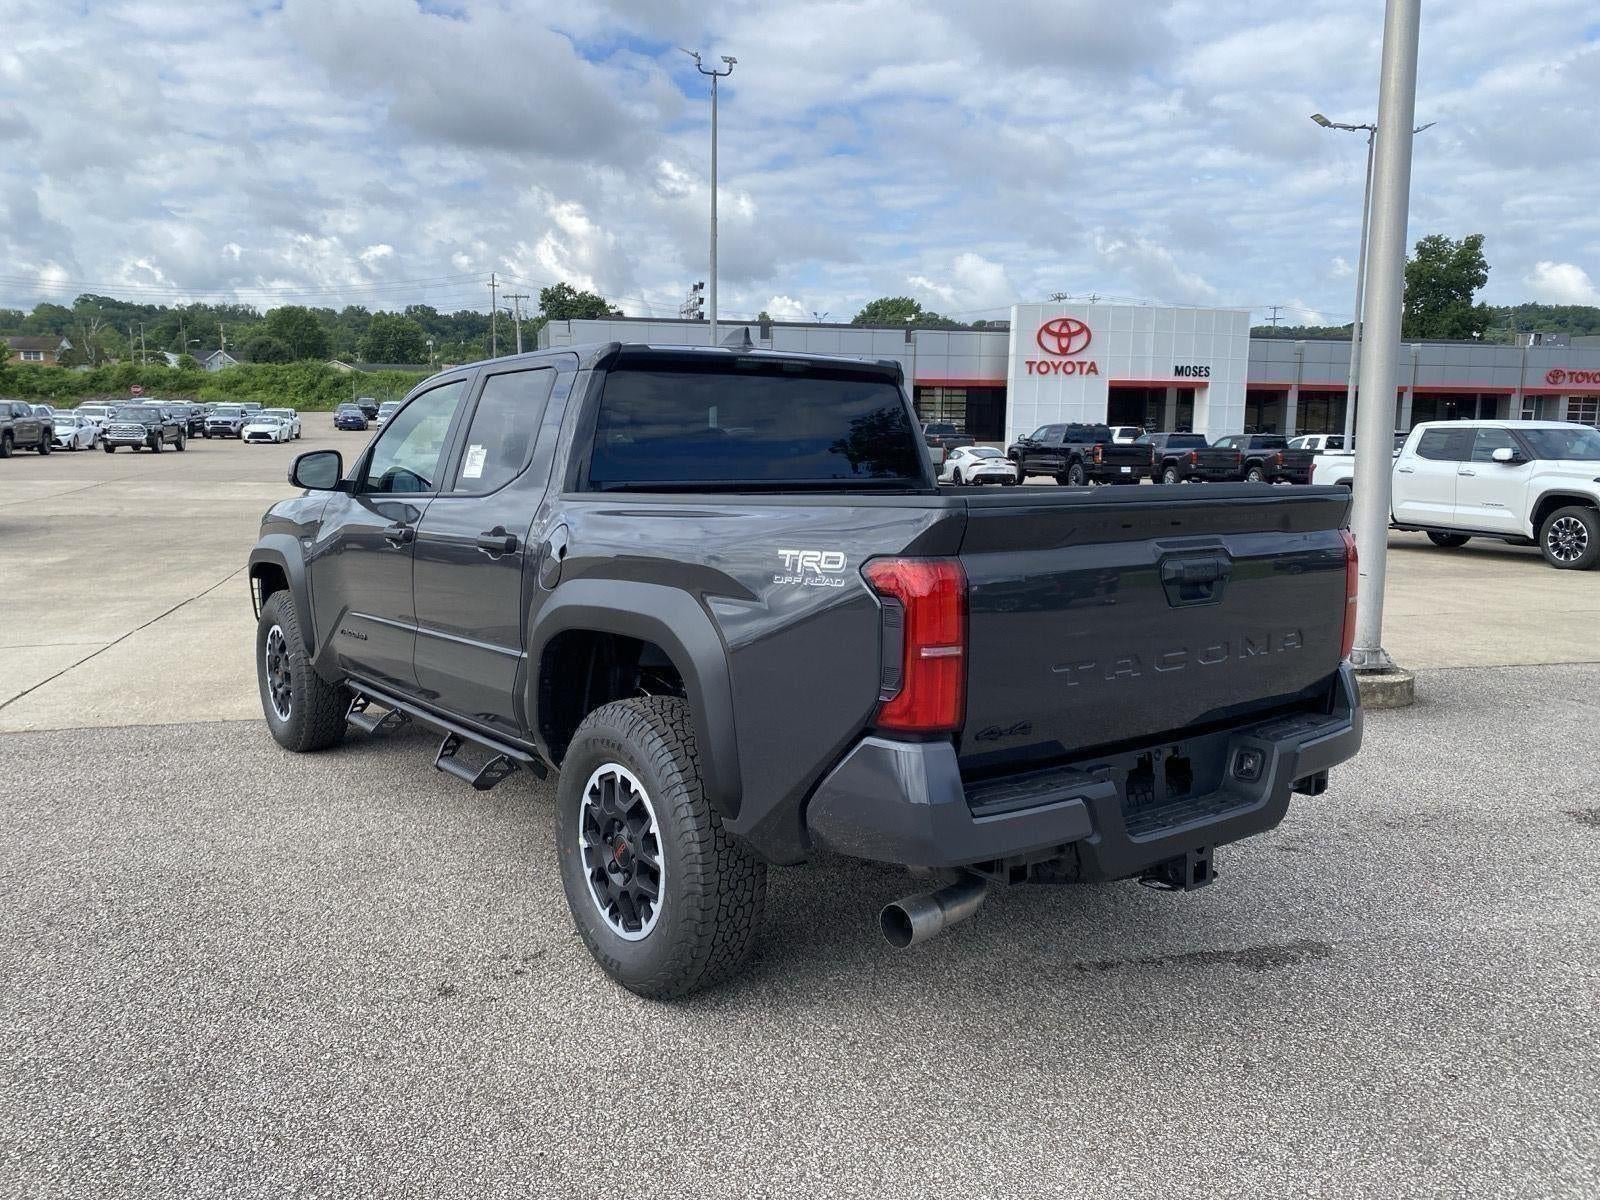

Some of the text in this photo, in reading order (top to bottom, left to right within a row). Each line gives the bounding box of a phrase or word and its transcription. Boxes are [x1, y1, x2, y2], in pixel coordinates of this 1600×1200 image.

[1025, 360, 1099, 376] TOYOTA
[1174, 365, 1211, 378] MOSES
[777, 549, 847, 574] TRD
[773, 575, 845, 587] OFF ROAD
[1050, 629, 1304, 686] TACOMA
